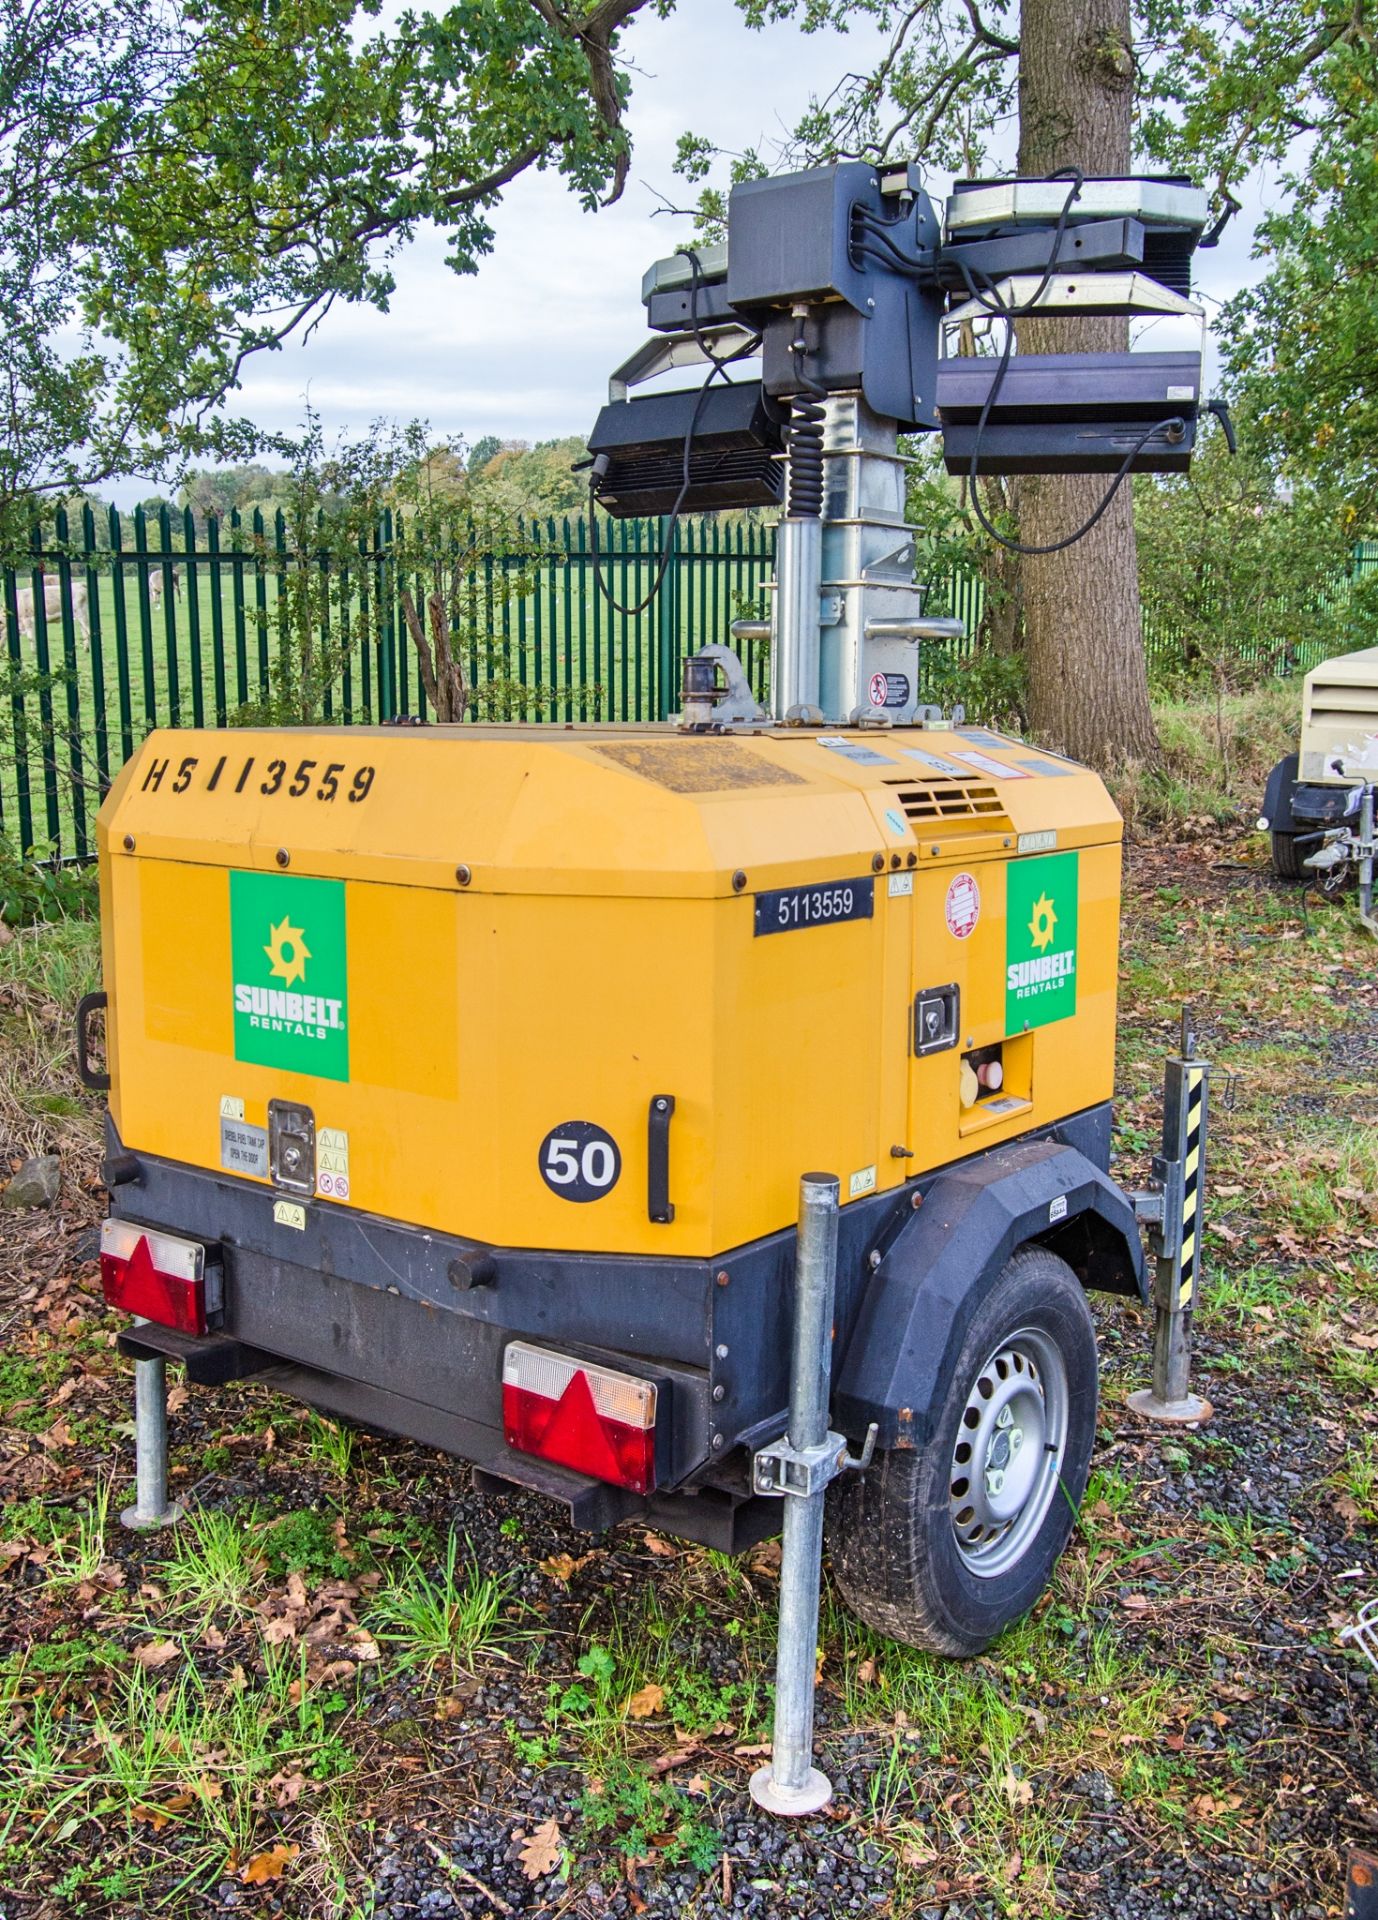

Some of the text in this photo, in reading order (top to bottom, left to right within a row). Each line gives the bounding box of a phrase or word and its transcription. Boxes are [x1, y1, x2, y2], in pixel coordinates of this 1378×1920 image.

[141, 756, 376, 803] H5113559
[778, 888, 853, 925] 5113559
[1007, 949, 1075, 991] SUNBELT
[1016, 977, 1065, 1000] RENTALS
[235, 983, 343, 1030] SUNBELT
[250, 1016, 327, 1040] RENTALS
[545, 1138, 615, 1187] 50
